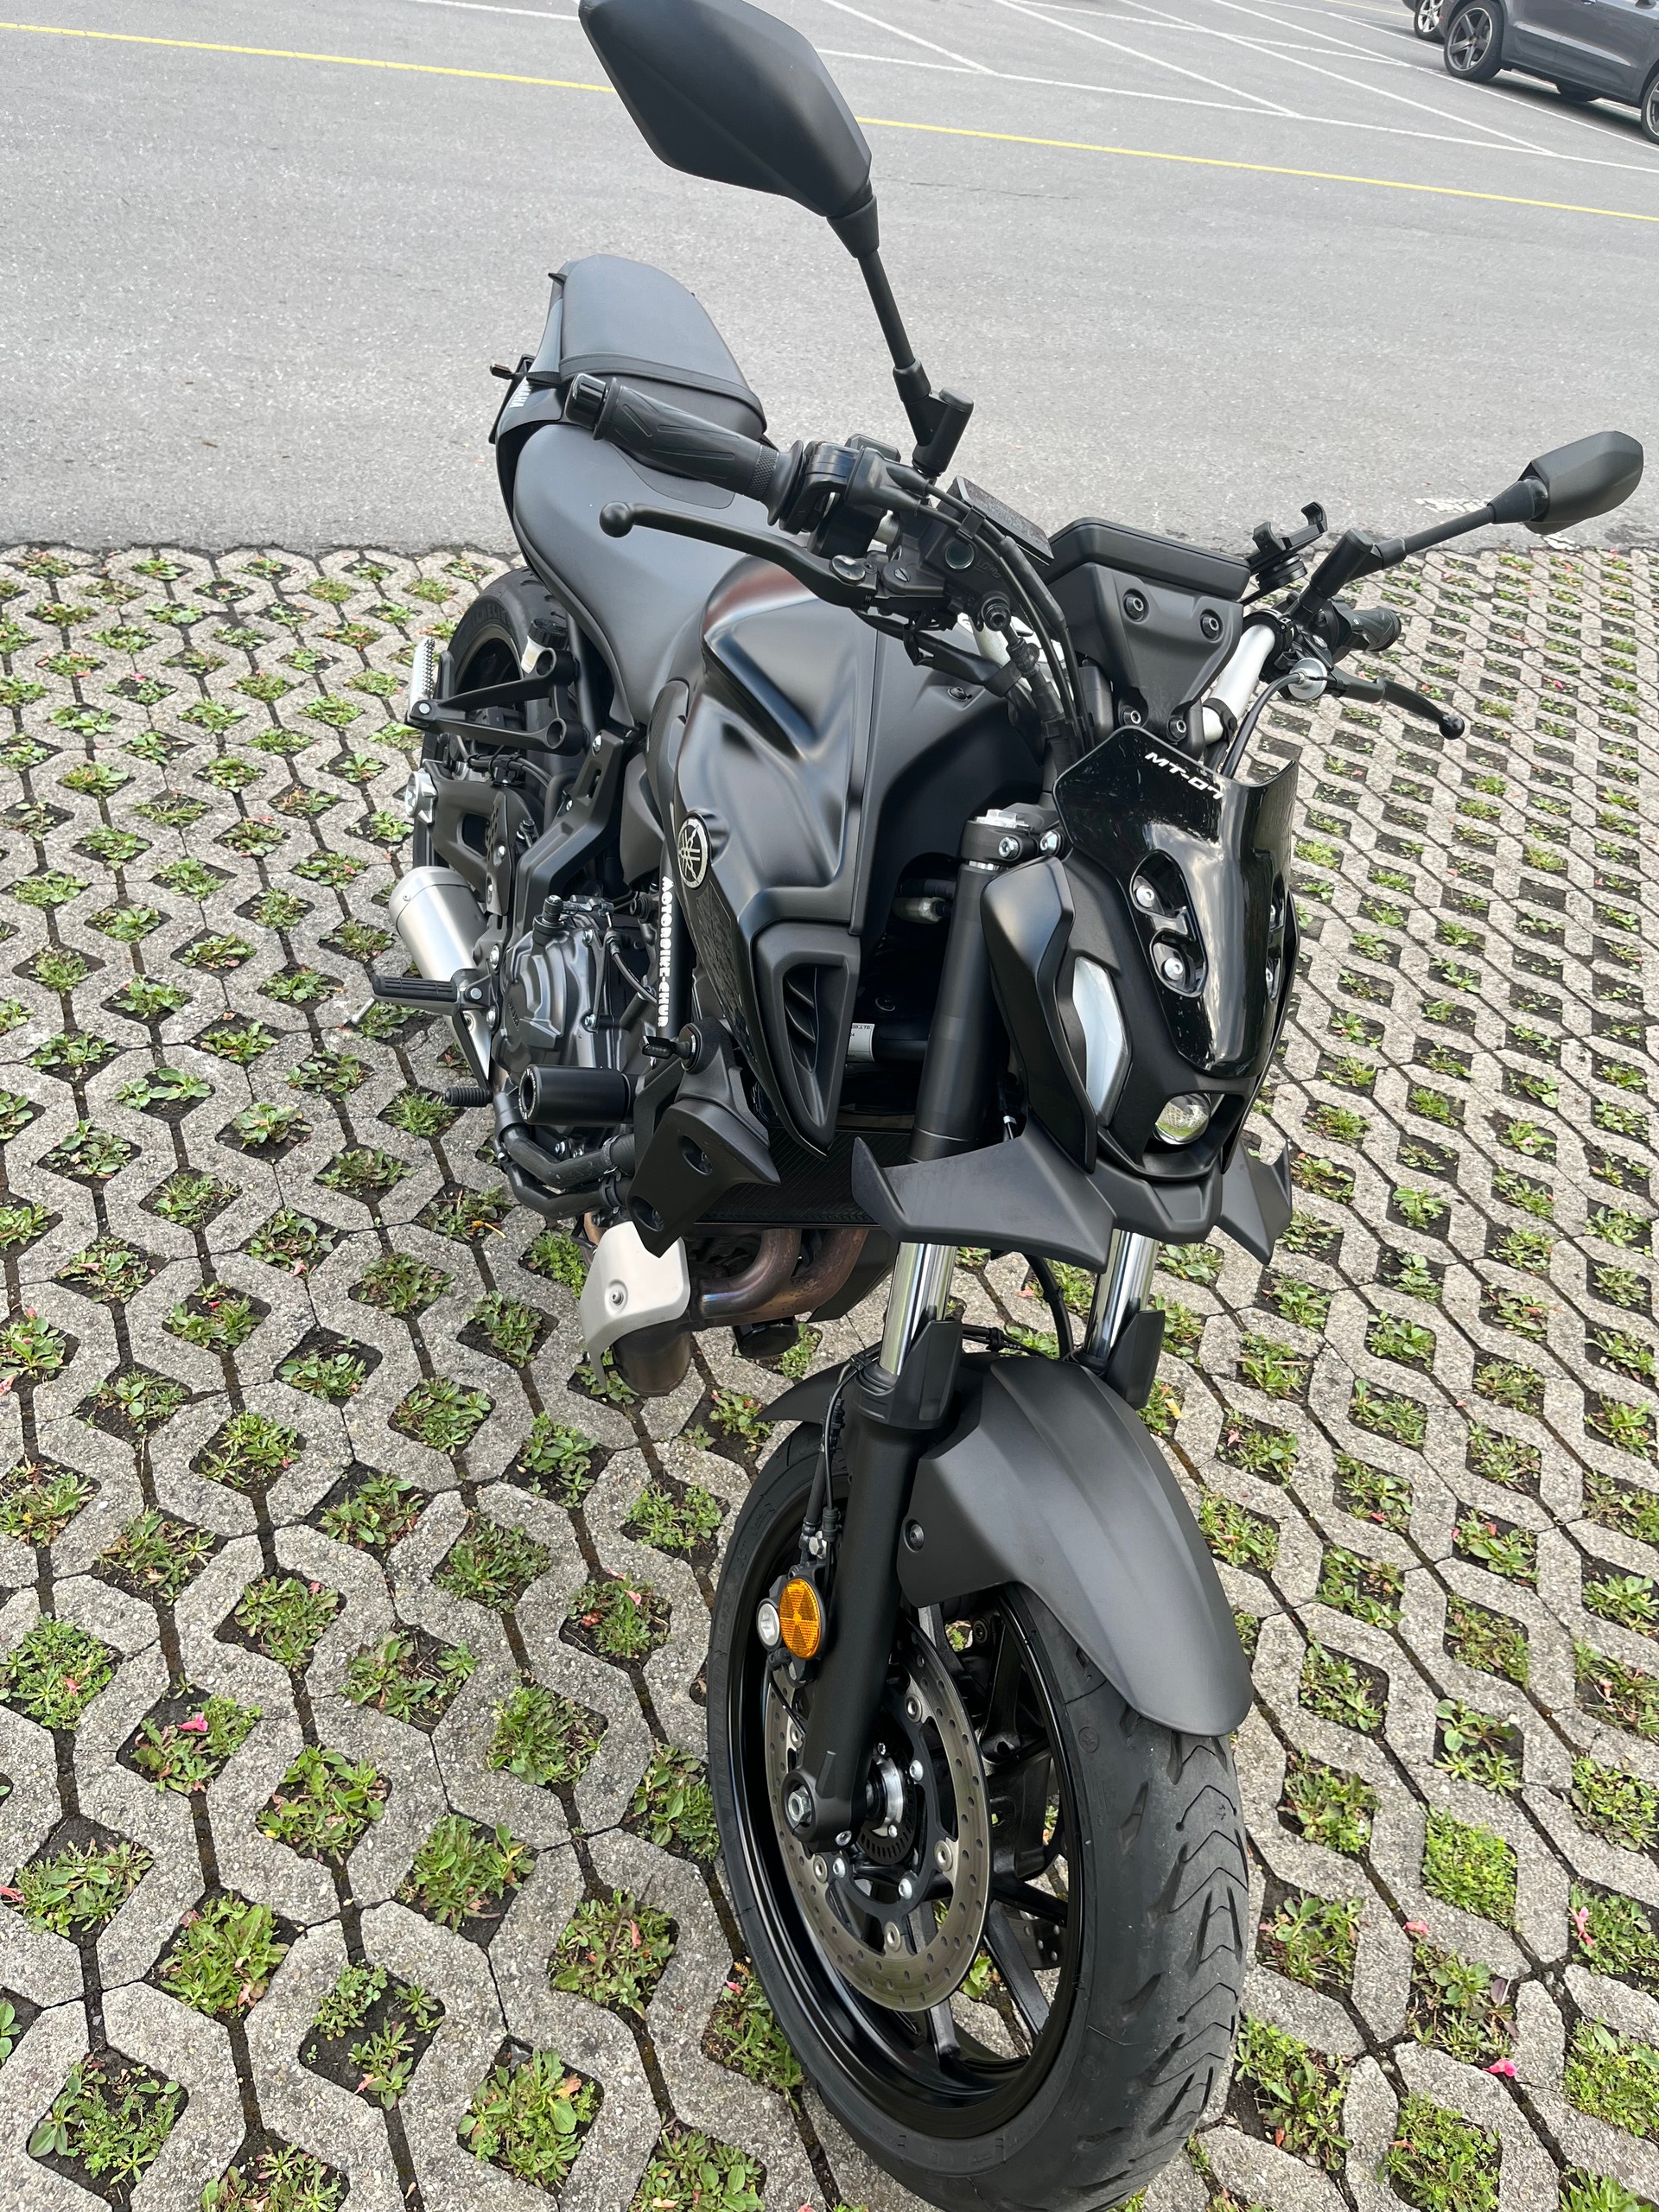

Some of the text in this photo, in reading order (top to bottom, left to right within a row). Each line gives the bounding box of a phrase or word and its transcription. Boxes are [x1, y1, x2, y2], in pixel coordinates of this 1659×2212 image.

[509, 376, 532, 409] MAHA
[1144, 752, 1224, 800] MT-07
[658, 875, 674, 1027] MOTORBIKE-CHUR
